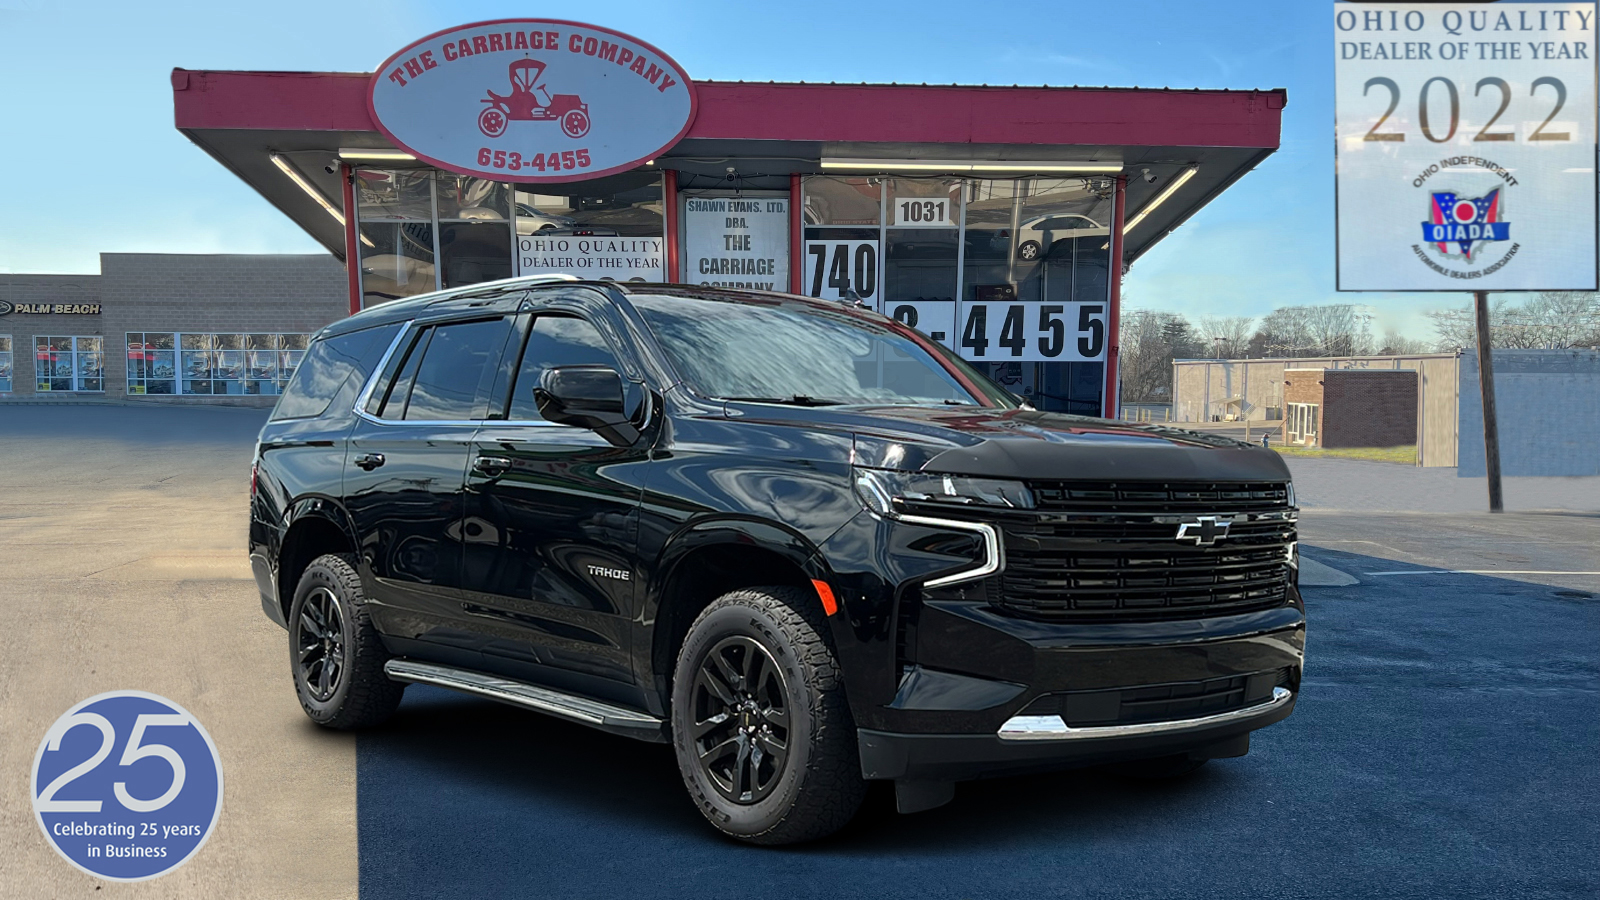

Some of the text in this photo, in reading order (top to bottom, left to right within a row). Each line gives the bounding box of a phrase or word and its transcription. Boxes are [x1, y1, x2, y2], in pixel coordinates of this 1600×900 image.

[1336, 10, 1593, 36] OHIO QUALITY
[1340, 42, 1589, 60] DEALER OF THE YEAR
[388, 31, 677, 94] THE CARRIAGE COMPANY
[1362, 76, 1571, 143] 2022
[477, 147, 592, 172] 653-4455
[1412, 156, 1519, 188] OHIO INDEPENDENT
[688, 201, 726, 212] SHAWN
[766, 202, 785, 213] LTD.
[901, 201, 944, 221] 1031
[725, 217, 748, 228] DBA.
[1432, 224, 1495, 240] OIADA
[520, 240, 661, 254] OHIO QUALITY
[723, 235, 751, 251] THE
[523, 257, 660, 268] DEALER OF THE YEAR
[699, 257, 775, 275] CARRIAGE
[1411, 242, 1521, 280] AUTOMOBILE DEALERS ASSOCIATION
[809, 243, 875, 298] 740
[14, 303, 100, 314] PALM BEACH
[587, 565, 630, 580] TAHOE
